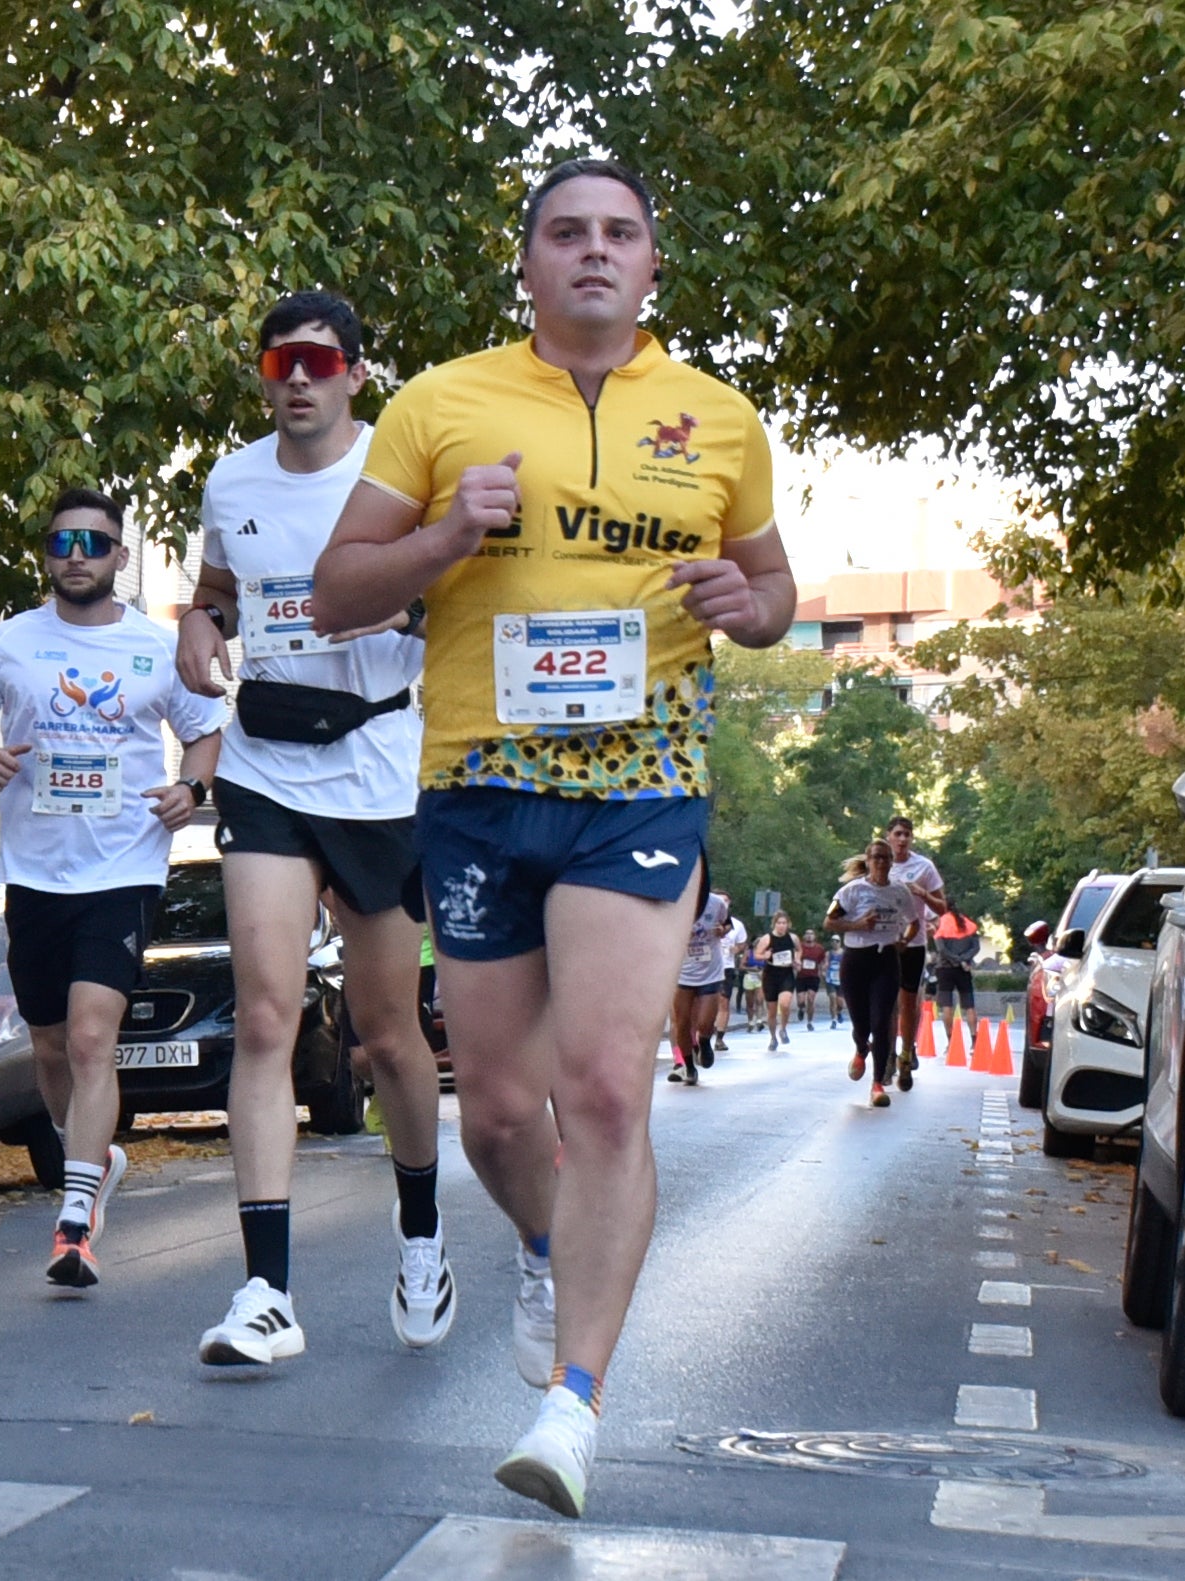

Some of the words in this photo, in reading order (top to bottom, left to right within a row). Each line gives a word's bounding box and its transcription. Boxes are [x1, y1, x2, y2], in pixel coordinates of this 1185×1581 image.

[555, 505, 703, 554] Vigilsa
[533, 650, 607, 676] 422
[49, 771, 103, 788] 1218
[155, 1045, 192, 1064] DXH
